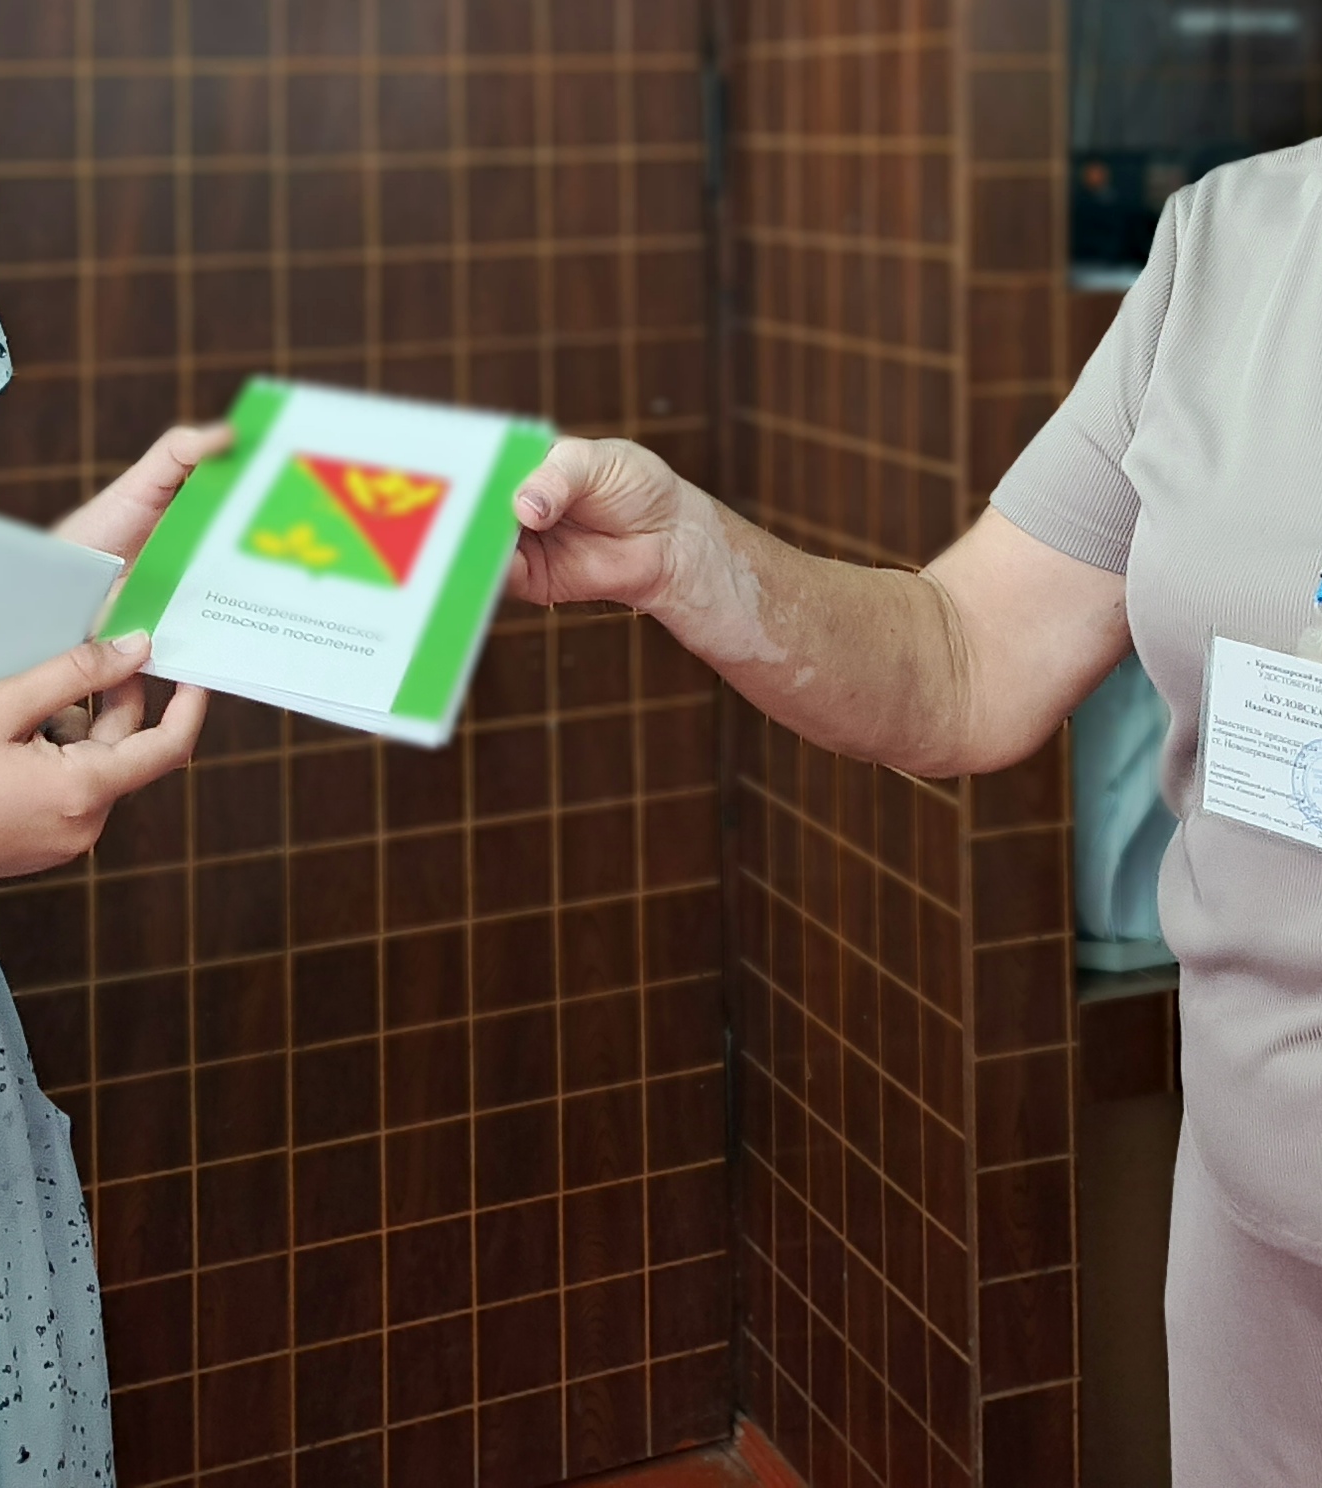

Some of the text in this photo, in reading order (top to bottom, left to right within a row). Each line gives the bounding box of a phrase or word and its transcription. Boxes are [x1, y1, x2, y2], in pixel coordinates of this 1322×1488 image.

[201, 608, 375, 657] сельское поселение
[204, 590, 385, 642] Новодеревянковское
